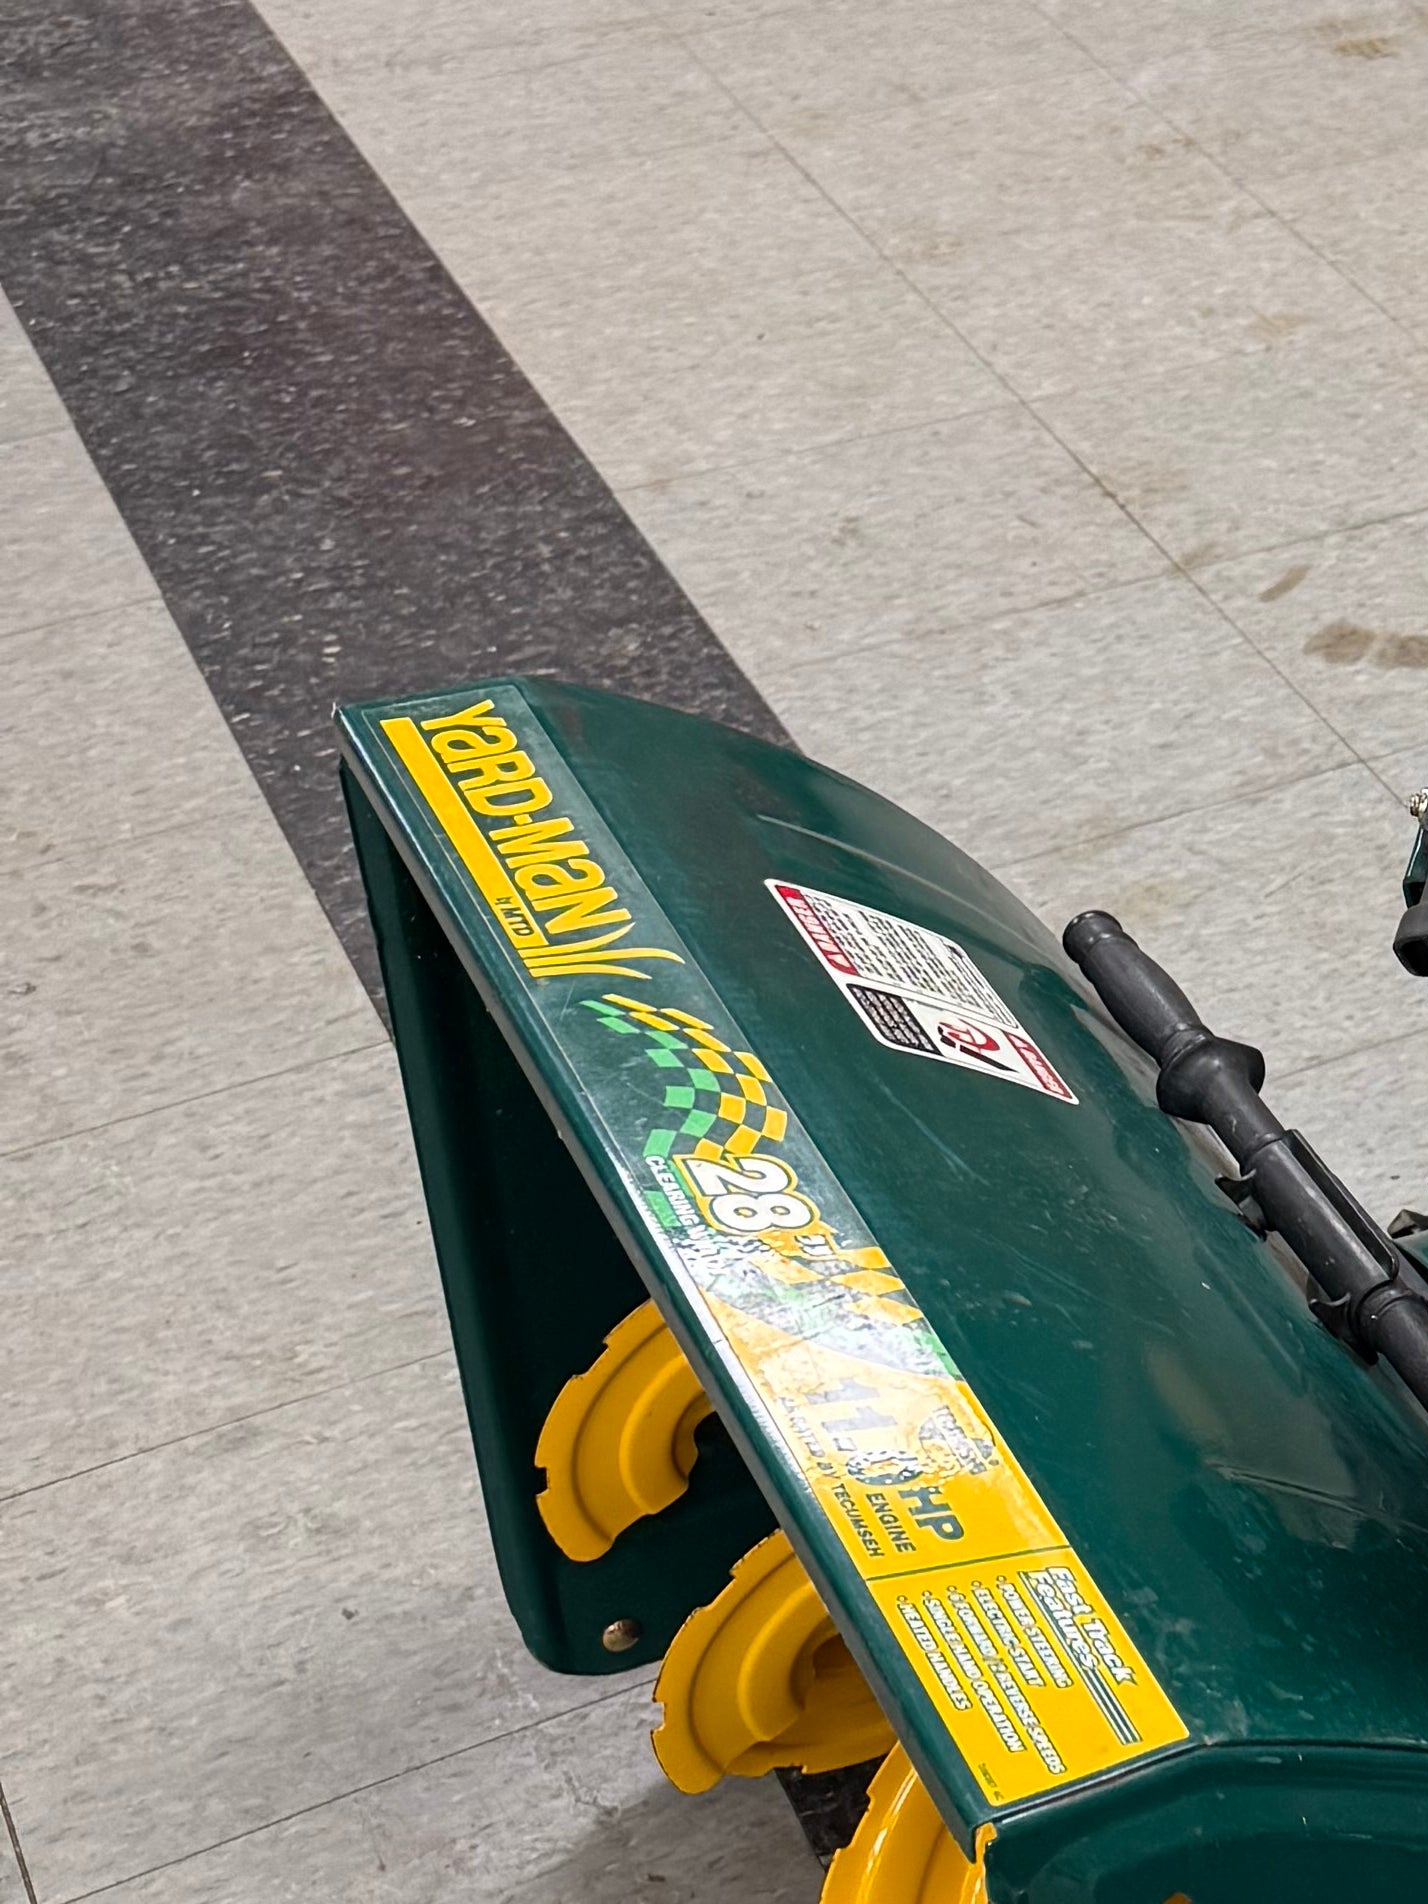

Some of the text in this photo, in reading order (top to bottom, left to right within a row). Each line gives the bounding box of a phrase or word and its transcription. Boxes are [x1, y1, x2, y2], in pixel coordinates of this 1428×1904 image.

[496, 907, 535, 937] MTD
[645, 1155, 700, 1227] CLEARING
[816, 1461, 841, 1480] BY
[831, 1483, 885, 1558] TECUMSEH
[866, 1492, 917, 1553] ENGINE
[898, 1485, 965, 1541] HP
[898, 1599, 973, 1711] HEATED HANDLES
[973, 1587, 1047, 1687] ELECTRIC START
[998, 1582, 1075, 1688] POWER STEERING
[1029, 1571, 1100, 1671] Features
[1046, 1567, 1139, 1686] Fast Track
[923, 1598, 963, 1644] SINGLE
[950, 1642, 985, 1680] HAND
[971, 1678, 1027, 1753] OPERATION
[957, 1599, 999, 1656] FORWARD
[996, 1671, 1041, 1728] REVERSE
[1026, 1724, 1067, 1775] SPEEDS
